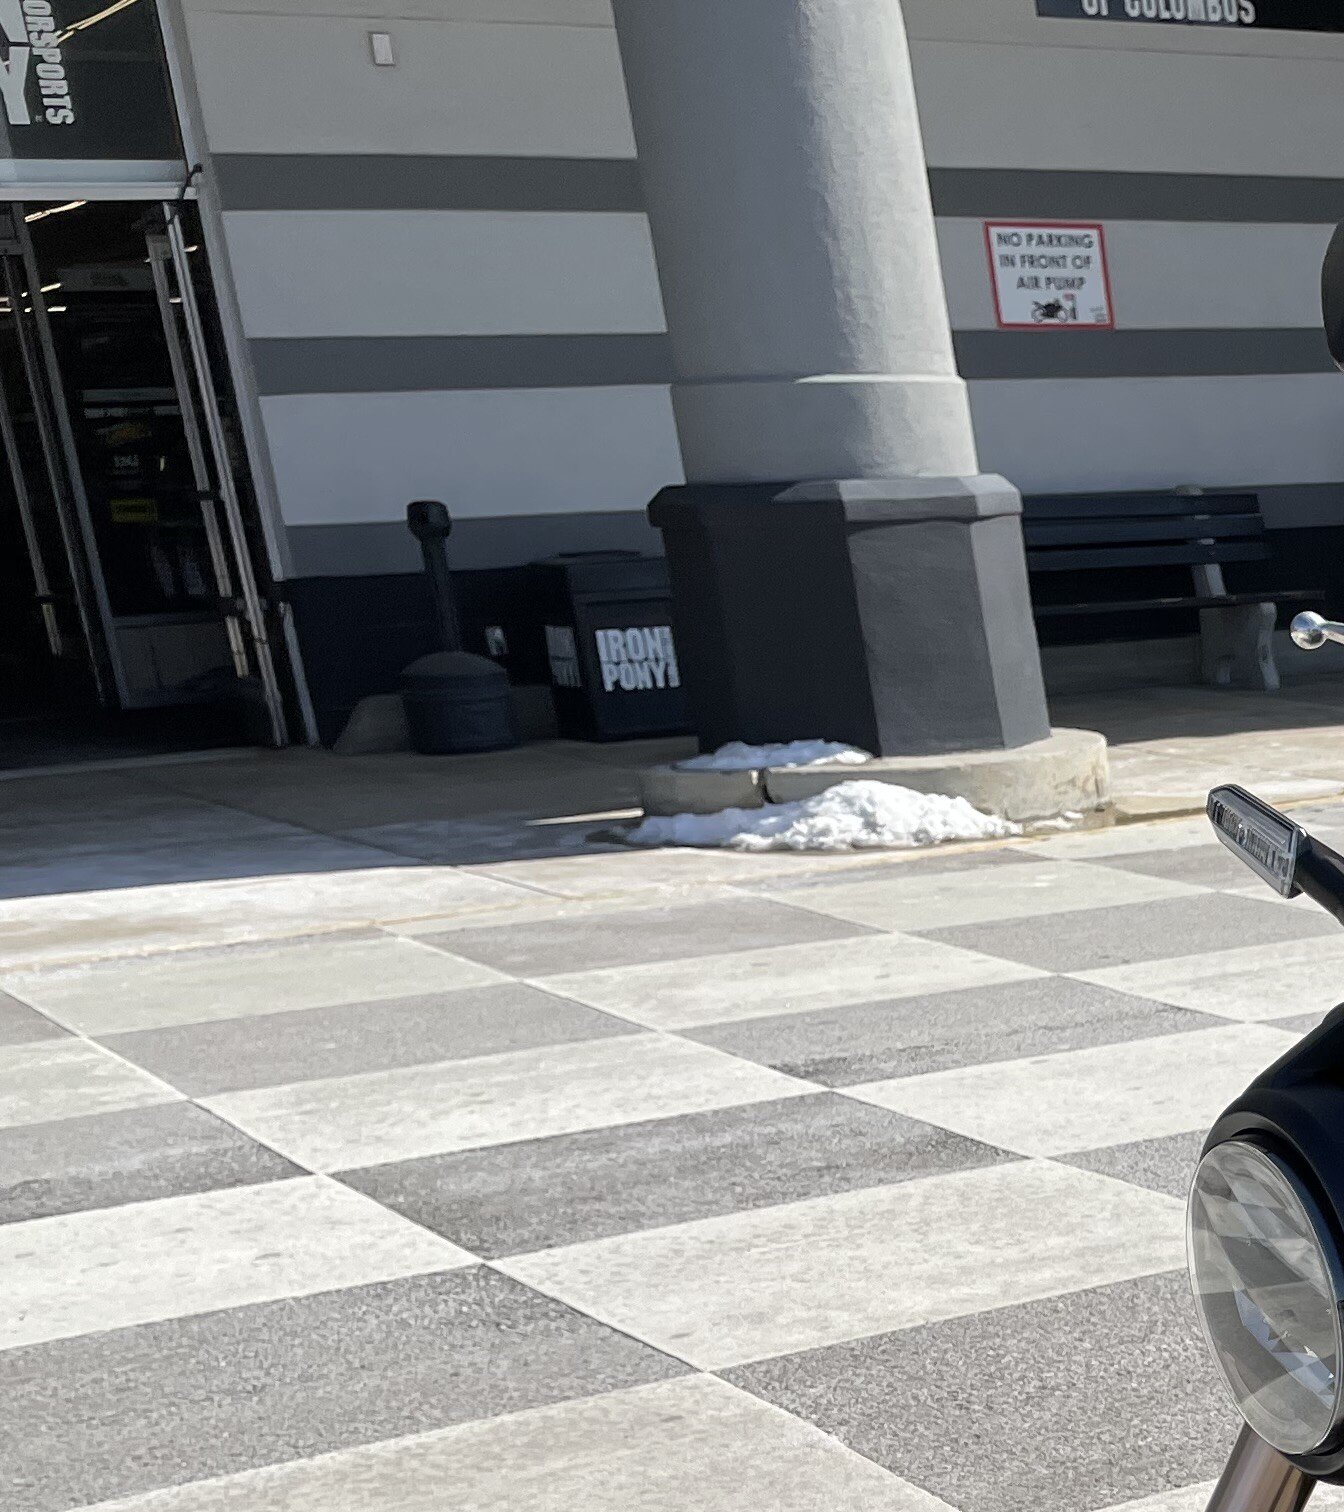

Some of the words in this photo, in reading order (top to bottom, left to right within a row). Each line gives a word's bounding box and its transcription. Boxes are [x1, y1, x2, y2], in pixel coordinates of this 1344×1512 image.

[996, 232, 1022, 247] NO
[1025, 233, 1095, 249] PARKING
[998, 254, 1016, 268] IN
[1019, 254, 1068, 269] FRONT
[1071, 254, 1092, 269] OF
[1016, 275, 1040, 290] AIR
[1044, 276, 1087, 291] PUMP
[595, 627, 665, 662] IRON
[601, 659, 667, 692] PONY
